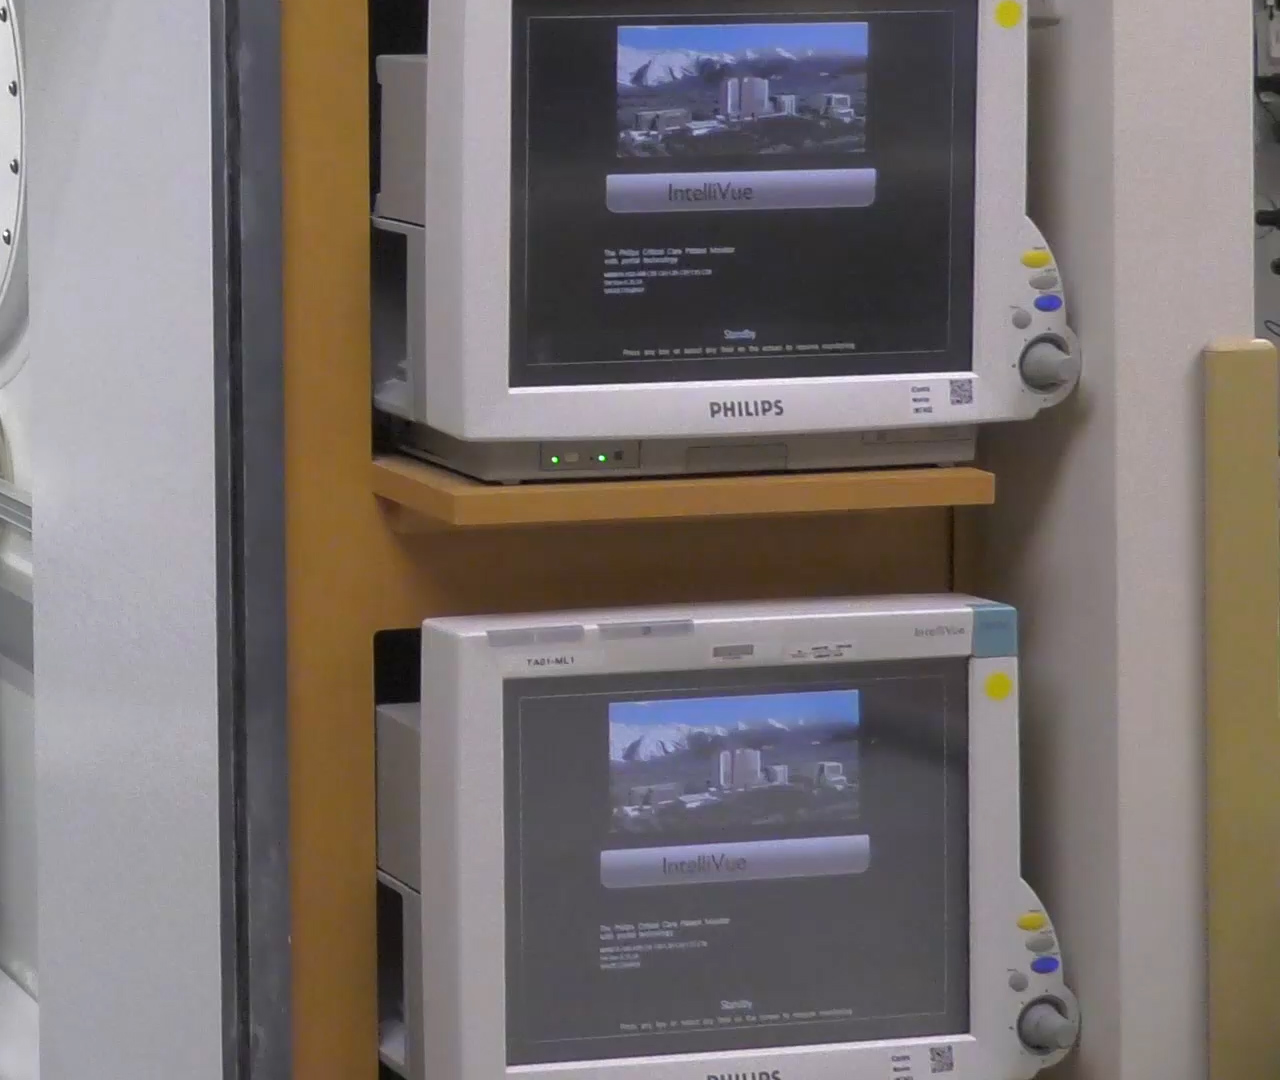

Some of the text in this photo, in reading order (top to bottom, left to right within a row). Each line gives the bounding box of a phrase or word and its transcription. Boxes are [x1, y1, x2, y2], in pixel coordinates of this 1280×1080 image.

[669, 182, 754, 201] IntelliVue
[709, 399, 784, 418] PHILIPS
[662, 853, 747, 874] IntelliVue
